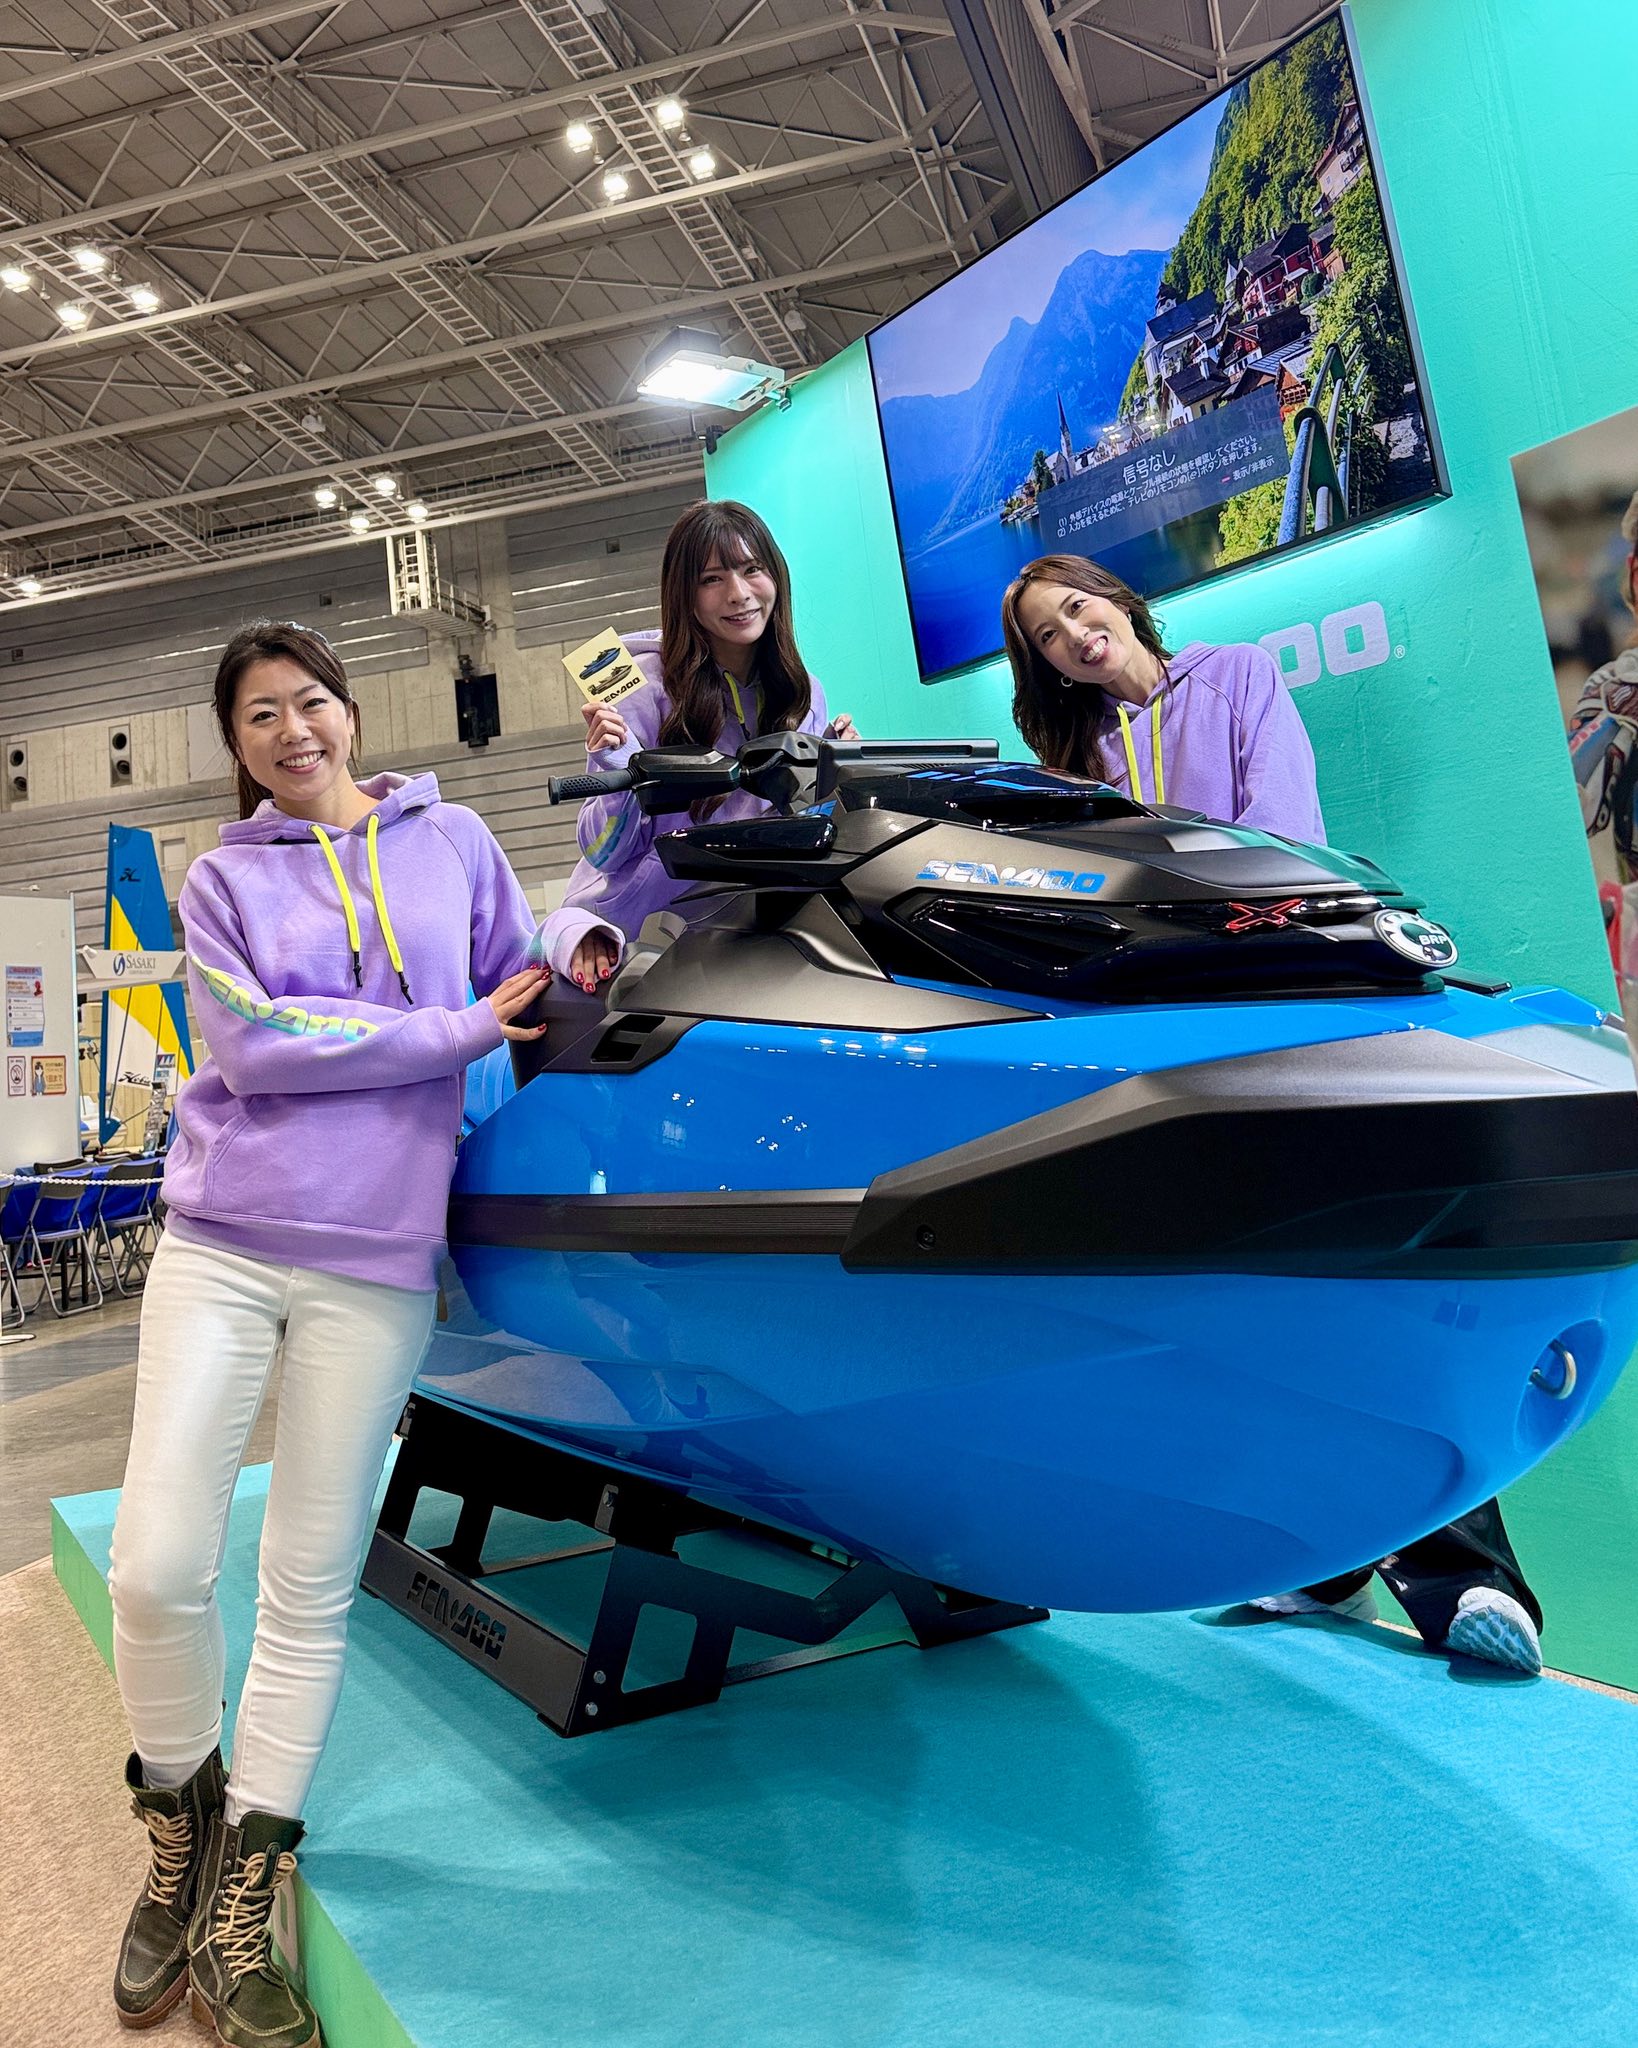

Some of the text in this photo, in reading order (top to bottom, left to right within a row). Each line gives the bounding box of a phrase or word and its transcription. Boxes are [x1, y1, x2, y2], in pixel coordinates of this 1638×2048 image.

[1123, 450, 1176, 486] 信号なし
[1233, 455, 1275, 480] 表示/非表示
[1419, 934, 1447, 945] BRP
